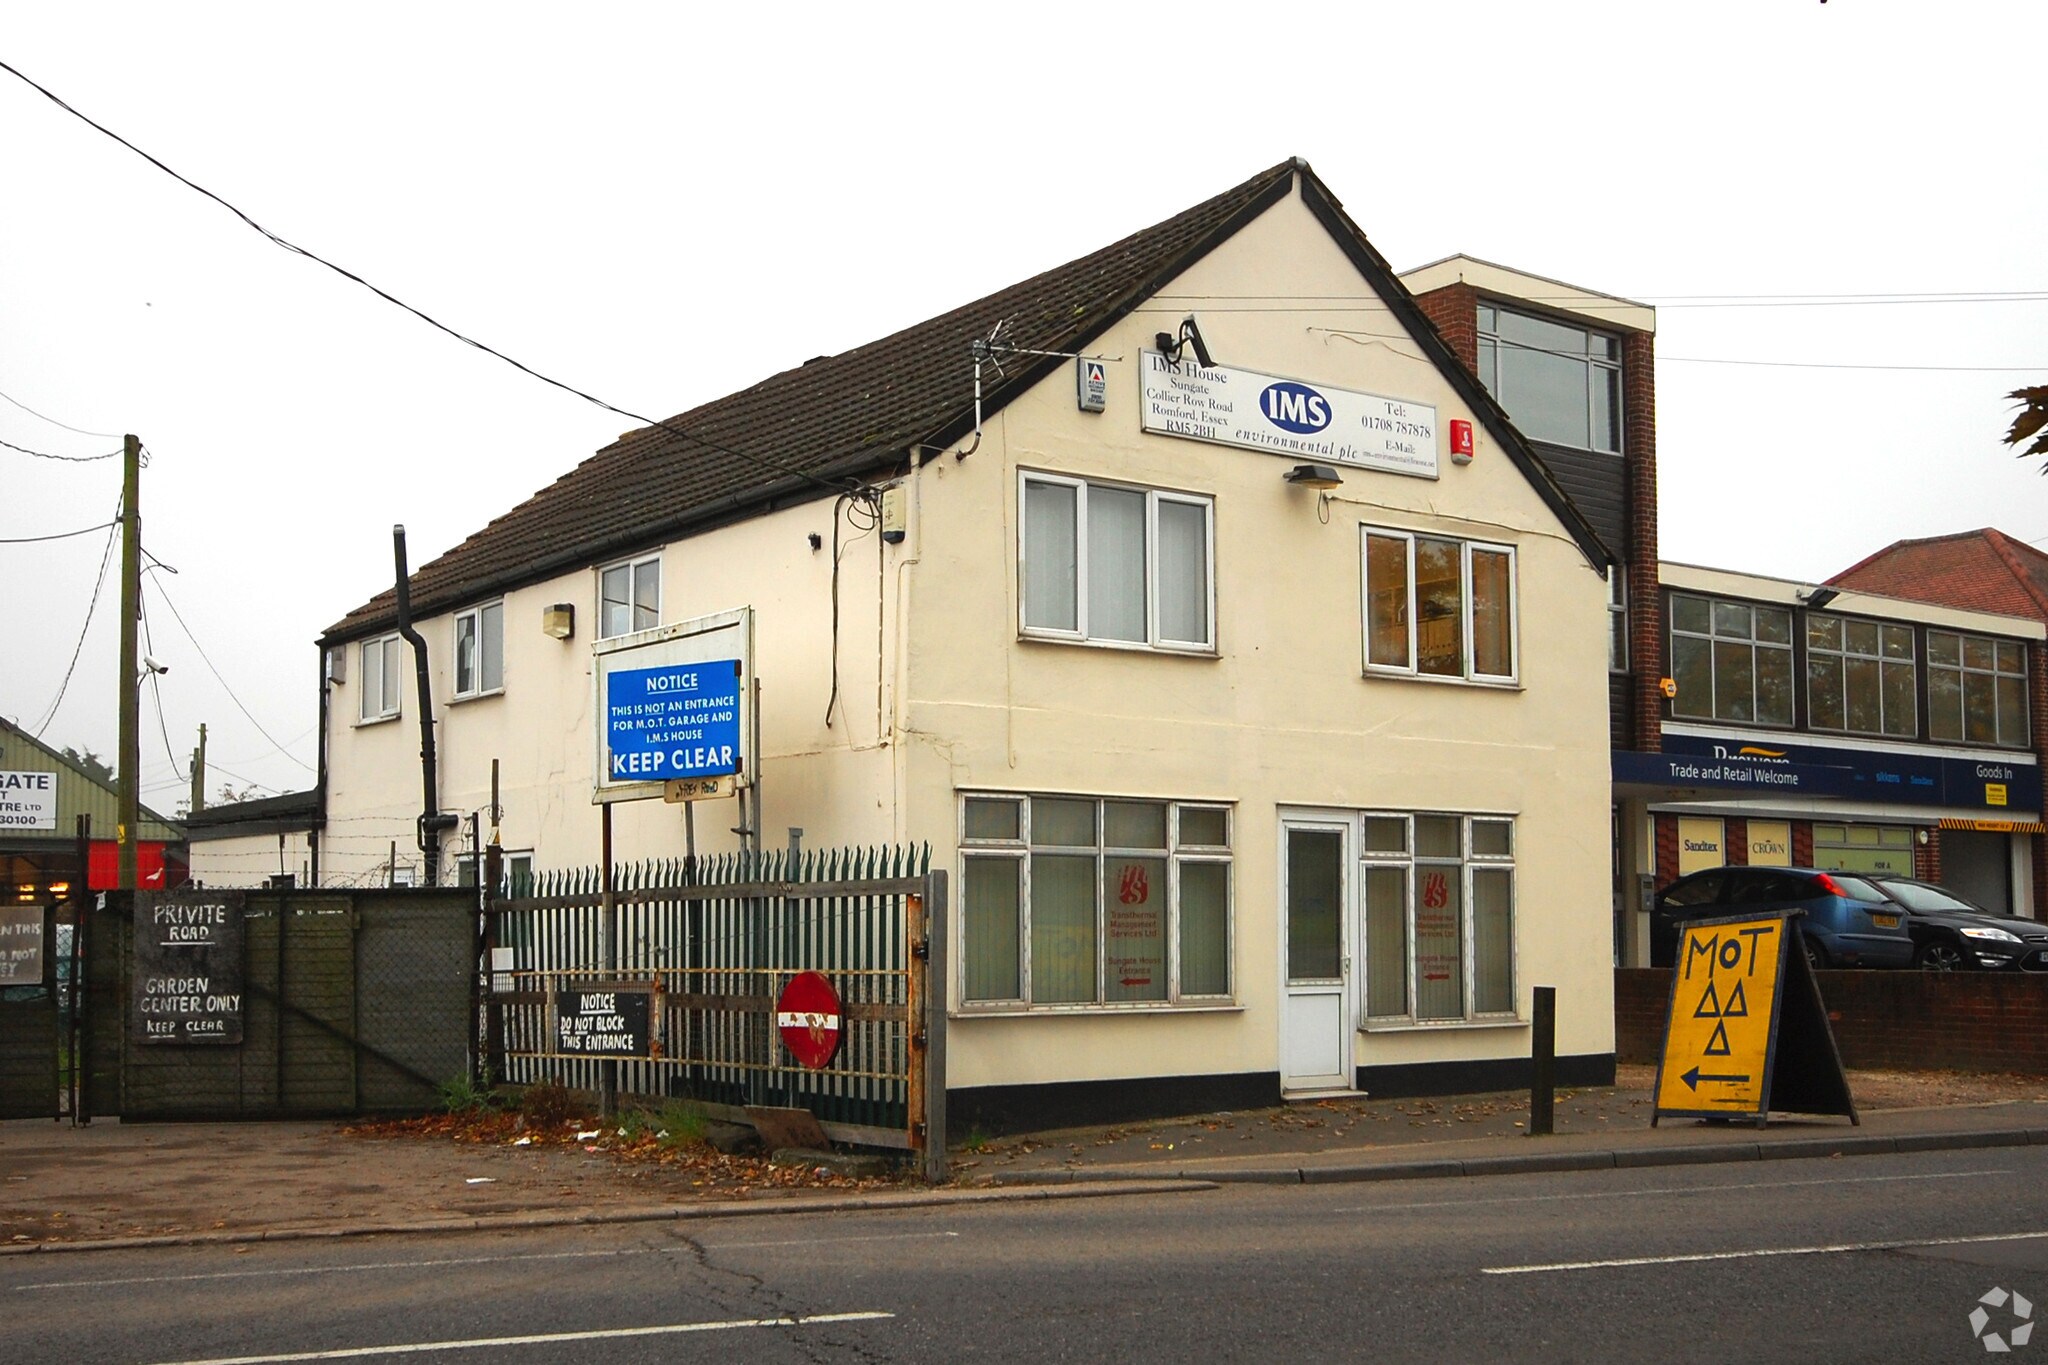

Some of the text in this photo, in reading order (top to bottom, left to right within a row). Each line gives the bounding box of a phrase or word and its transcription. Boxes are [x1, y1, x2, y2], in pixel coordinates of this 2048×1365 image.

[1153, 356, 1227, 383] IMS House
[1171, 377, 1209, 394] Sungate
[1147, 387, 1233, 412] Collier Row Road
[1268, 388, 1327, 428] IMS
[1152, 403, 1228, 425] Romford, Essex
[1384, 402, 1406, 417] Tel:
[1166, 420, 1216, 438] RM5 2BH
[1362, 415, 1431, 438] 01708 787878
[1235, 429, 1334, 455] environmental
[1339, 445, 1358, 460] plc
[646, 673, 698, 692] NOTICE
[612, 696, 735, 716] THIS IS NOT AN ENTRANCE
[613, 711, 733, 731] FOR M.O.T. GARAGE AND
[671, 729, 702, 741] HOUSE
[613, 745, 733, 774] KEEP CLEAR
[1669, 763, 1799, 785] Trade and Retail Welcome
[1976, 764, 2013, 780] Goods In
[1684, 839, 1718, 852] Sandtex
[1752, 841, 1785, 854] CROWN
[15, 923, 41, 935] THIS
[169, 926, 209, 941] ROAD
[146, 978, 209, 994] GARDEN
[140, 995, 240, 1013] CENTER ONLY
[580, 993, 615, 1010] NOTICE
[147, 1020, 223, 1033] KEEP CLEAR
[561, 1015, 625, 1032] DO NOT BLOCK
[562, 1034, 634, 1051] THIS ENTRANCE
